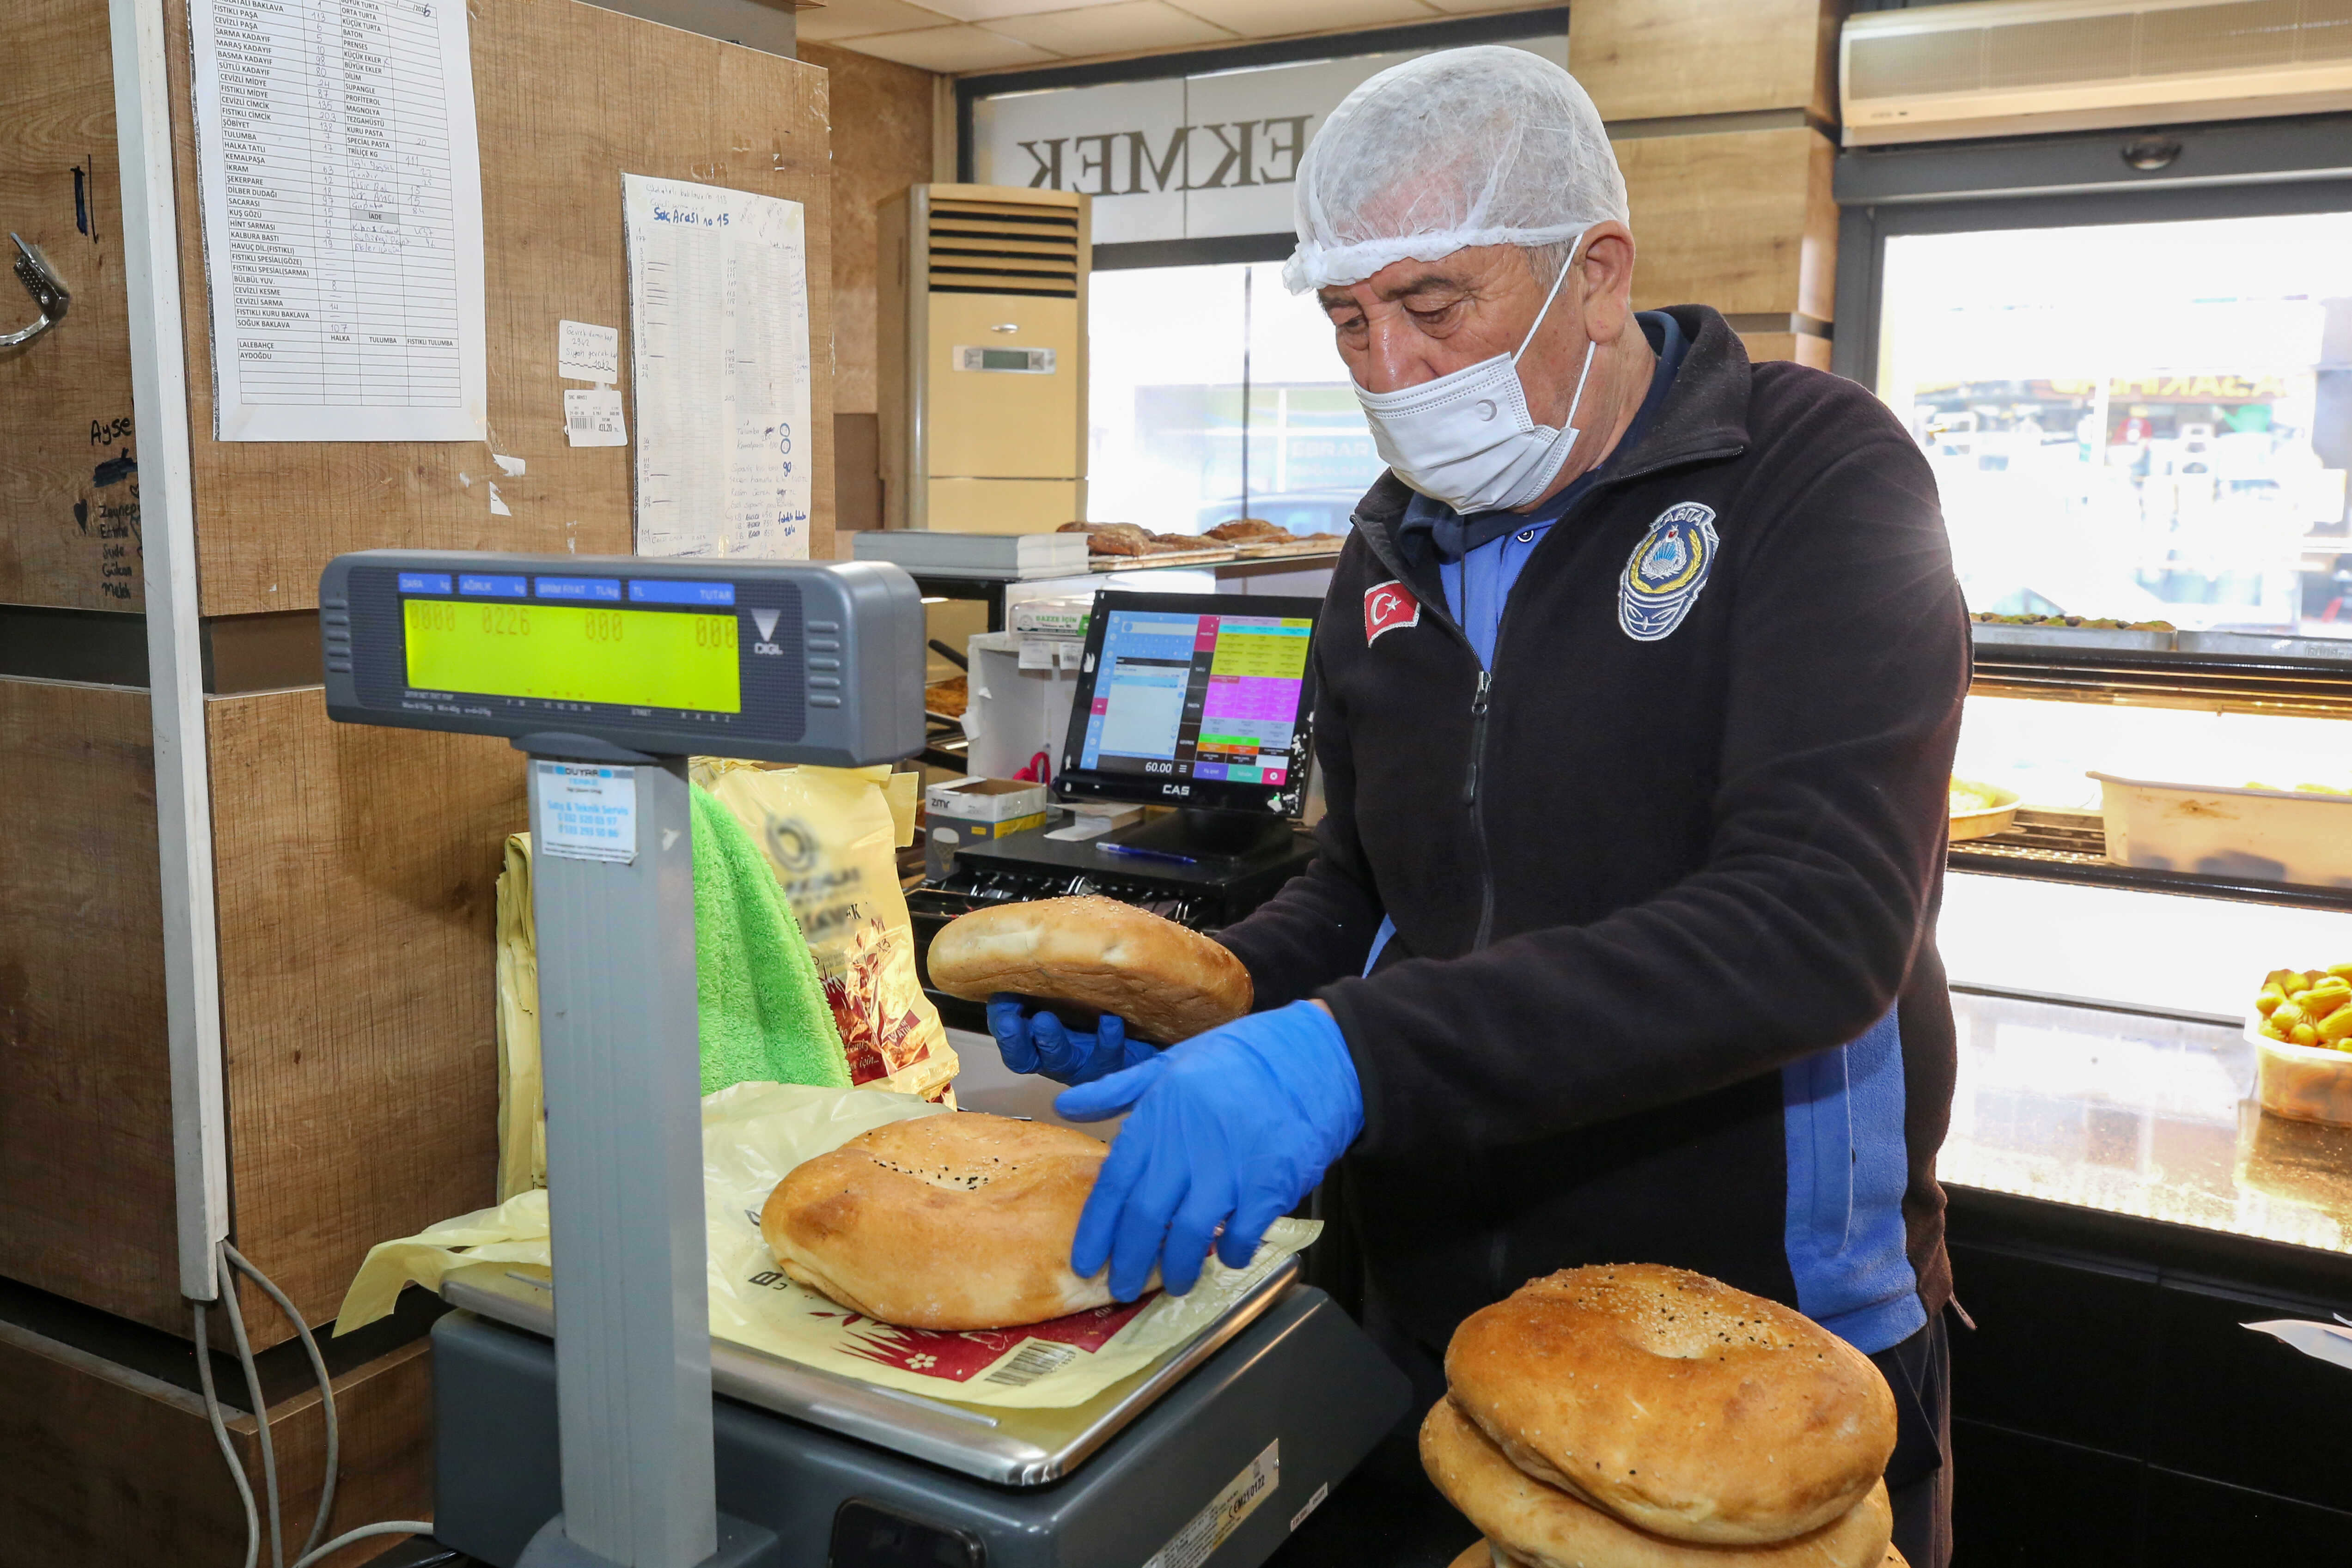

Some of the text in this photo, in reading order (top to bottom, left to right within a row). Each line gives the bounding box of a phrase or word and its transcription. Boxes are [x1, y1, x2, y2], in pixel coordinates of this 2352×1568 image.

[214, 5, 258, 19] FISTIKLI PAŞA
[253, 2, 284, 12] BAKLAVA
[361, 3, 379, 11] TURTA
[312, 12, 325, 22] 113
[342, 7, 376, 21] ORTA TURTA
[215, 17, 238, 26] CEVİZLİ
[342, 18, 381, 32] KÜÇÜK TURTA
[317, 23, 322, 31] 6
[216, 28, 271, 43] SARMA KADAYIF
[317, 34, 322, 43] 5
[343, 29, 363, 39] BATON
[216, 40, 272, 54] MARAŞ KADAYIF
[317, 45, 324, 55] 10
[344, 40, 368, 50] PRENSES
[218, 51, 273, 65] BASMA KADAYIF
[316, 56, 325, 66] 98
[344, 51, 363, 61] KÜÇÜK
[219, 62, 270, 76] SÜTLÜ KADAYIF
[345, 61, 364, 71] BÜYÜK
[316, 67, 327, 77] 80
[345, 72, 361, 81] DİLİM
[220, 73, 267, 87] CEVİZLİ MİDYE
[221, 85, 268, 98] FISTIKLI MİDYE
[346, 83, 375, 94] SUPANGLE
[222, 96, 269, 110] CEVİZLİ CİMCİK
[346, 94, 381, 106] PROFİTEROL
[222, 108, 271, 121] FISTIKLI CİMCİK
[347, 105, 380, 116] MAGNOLYA
[319, 112, 336, 122] 203
[347, 116, 384, 127] TEZGAHÜSTÜ
[223, 119, 250, 128] ŞÖBİYET
[224, 130, 257, 140] TULUMBA
[347, 126, 364, 134] KURU
[225, 142, 246, 151] HALKA
[347, 137, 390, 149] SPECİAL PASTA
[347, 148, 368, 157] TRİLİÇE
[225, 153, 266, 165] KEMALPAŞA
[226, 164, 249, 173] İKRAM
[323, 165, 334, 175] 63
[227, 175, 264, 186] ŞEKERPARE
[228, 186, 277, 199] DİLBER DUDAĞI
[324, 187, 332, 197] 18
[229, 198, 260, 207] SACARASI
[229, 209, 262, 219] KUŞ GÖZÜ
[324, 208, 333, 217] 15
[369, 212, 382, 221] İADE
[231, 219, 276, 231] HİNT SARMASI
[717, 213, 729, 227] 15
[231, 231, 260, 241] KALBURA
[232, 243, 295, 255] HAVUÇ DİL.(FISTIKLI)
[232, 254, 303, 267] FISTIKLI SPESİAL(GÖZE)
[233, 265, 310, 278] FISTIKLI SPESİAL(SARMA)
[234, 275, 259, 283] BÜLBÜL
[235, 286, 258, 295] CEVİZLİ
[332, 280, 337, 291] 8
[236, 298, 259, 306] CEVİZLİ
[237, 309, 261, 317] FISTIKLI
[238, 319, 260, 328] SOĞUK
[331, 323, 347, 333] 107
[239, 341, 274, 350] LALEBAHÇE
[240, 351, 272, 359] AYDOĞDU
[1146, 761, 1172, 774] 60.00
[1163, 784, 1190, 796] CAS
[932, 797, 951, 809] zmr
